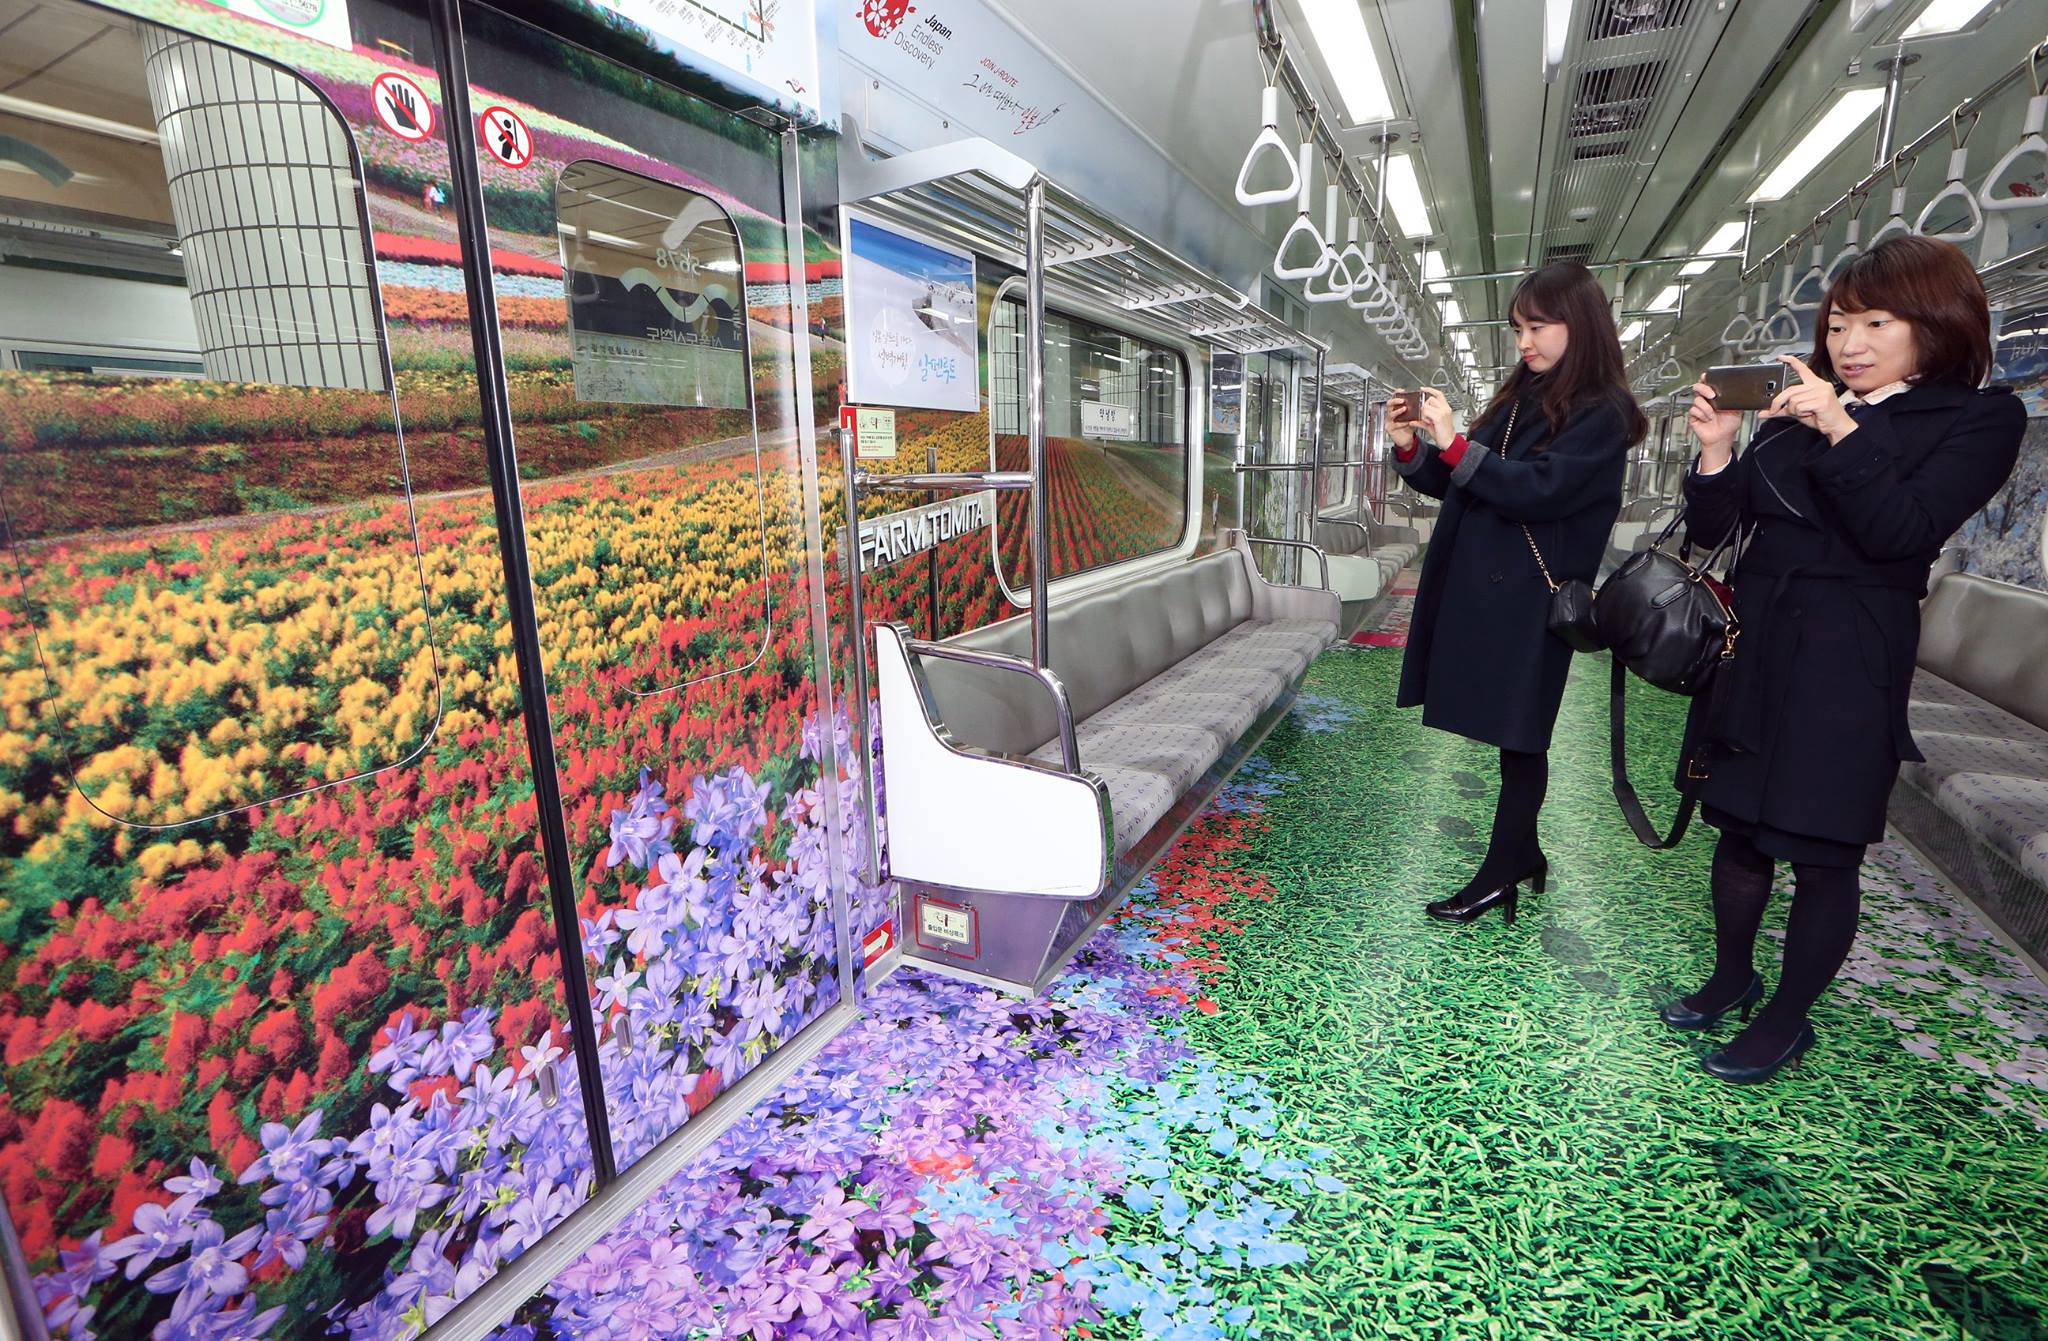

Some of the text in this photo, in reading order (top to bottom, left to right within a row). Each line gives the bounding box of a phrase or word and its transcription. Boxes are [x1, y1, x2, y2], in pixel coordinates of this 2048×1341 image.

[911, 25, 944, 56] Endless
[924, 14, 952, 41] Japan.
[980, 58, 1019, 88] JOIN J-ROUTE
[859, 500, 984, 572] FARM TOMITA
